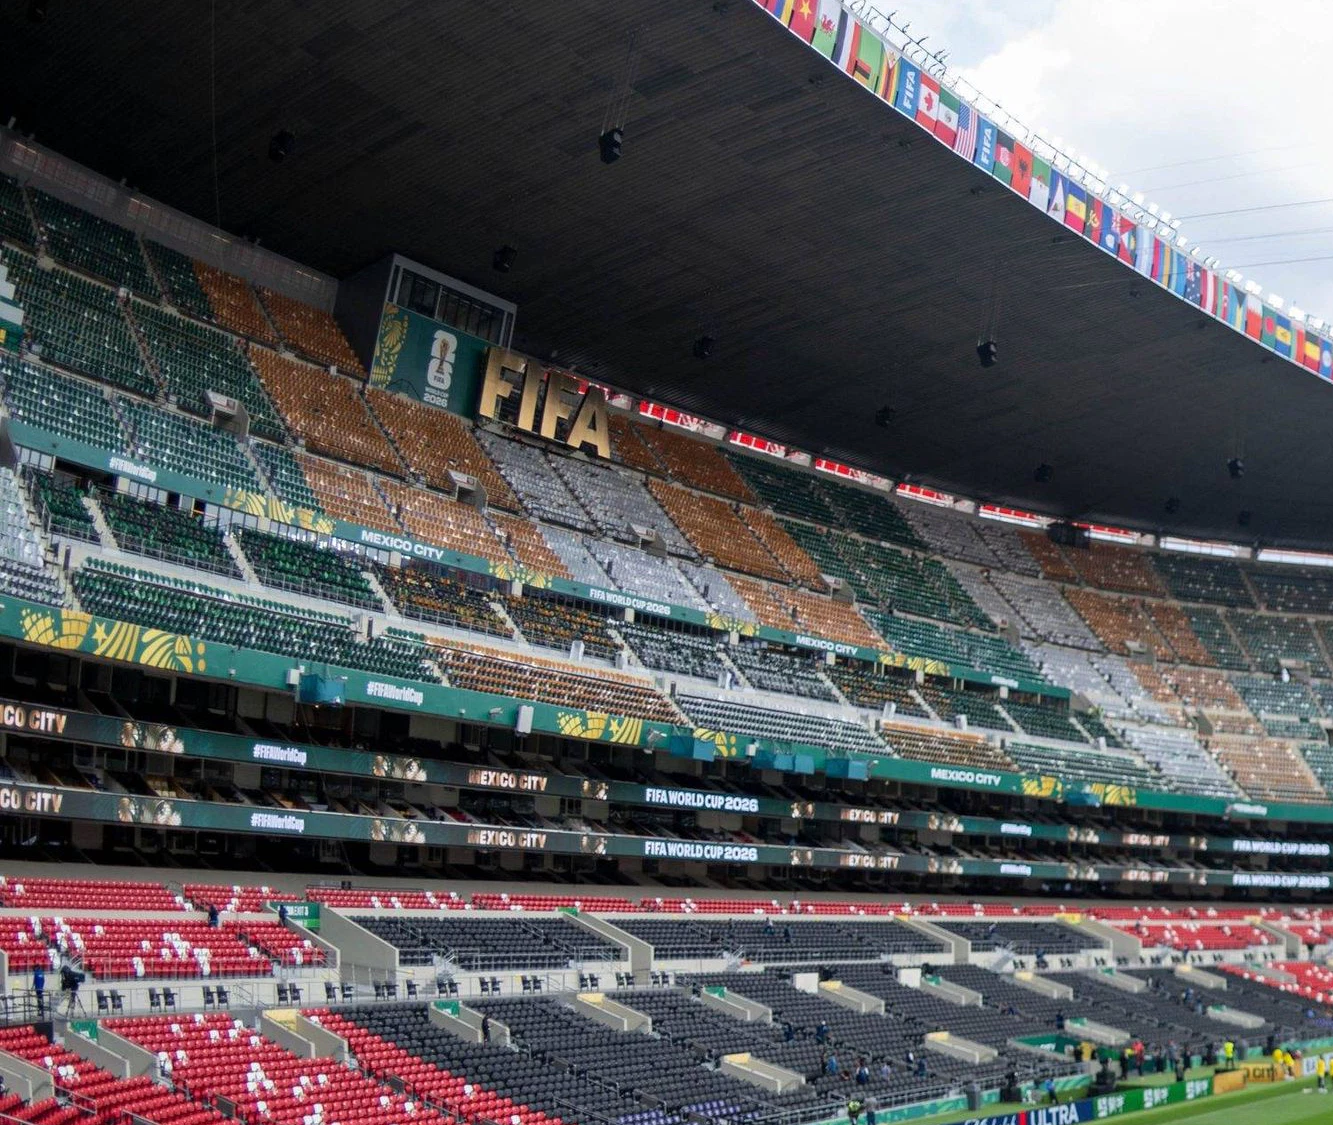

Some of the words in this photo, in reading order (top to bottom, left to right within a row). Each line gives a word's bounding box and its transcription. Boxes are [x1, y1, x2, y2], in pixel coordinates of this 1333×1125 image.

[903, 71, 916, 109] FIFA
[981, 128, 993, 165] FIFA
[423, 393, 448, 407] 2026
[480, 346, 610, 459] FIFA
[361, 530, 411, 552] MEXICO
[413, 542, 444, 559] CITY
[590, 588, 604, 600] FIFA
[604, 590, 630, 606] WORLD
[631, 597, 646, 610] CUP
[645, 601, 670, 616] 2026
[796, 635, 834, 651] MEXICO
[835, 642, 858, 655] CITY
[367, 681, 423, 706] #FIFAWorldCup
[29, 710, 67, 734] CITY
[253, 744, 307, 766] #FIFAWorldCup
[468, 769, 516, 789] MEXICO
[518, 775, 548, 792] CITY
[931, 768, 974, 783] MEXICO
[975, 772, 1001, 786] CITY
[25, 792, 63, 813] CITY
[645, 788, 668, 806] FIFA
[668, 790, 703, 808] WORLD
[704, 792, 724, 810] CUP
[724, 796, 759, 813] 2026
[841, 808, 876, 823] MEXICO
[877, 811, 899, 825] CITY
[467, 830, 515, 848] MEXICO
[517, 833, 547, 849] CITY
[644, 841, 667, 857] FIFA
[667, 843, 703, 859] WORLD
[703, 844, 724, 860] CUP
[724, 846, 758, 862] 2026
[877, 856, 899, 869] CITY
